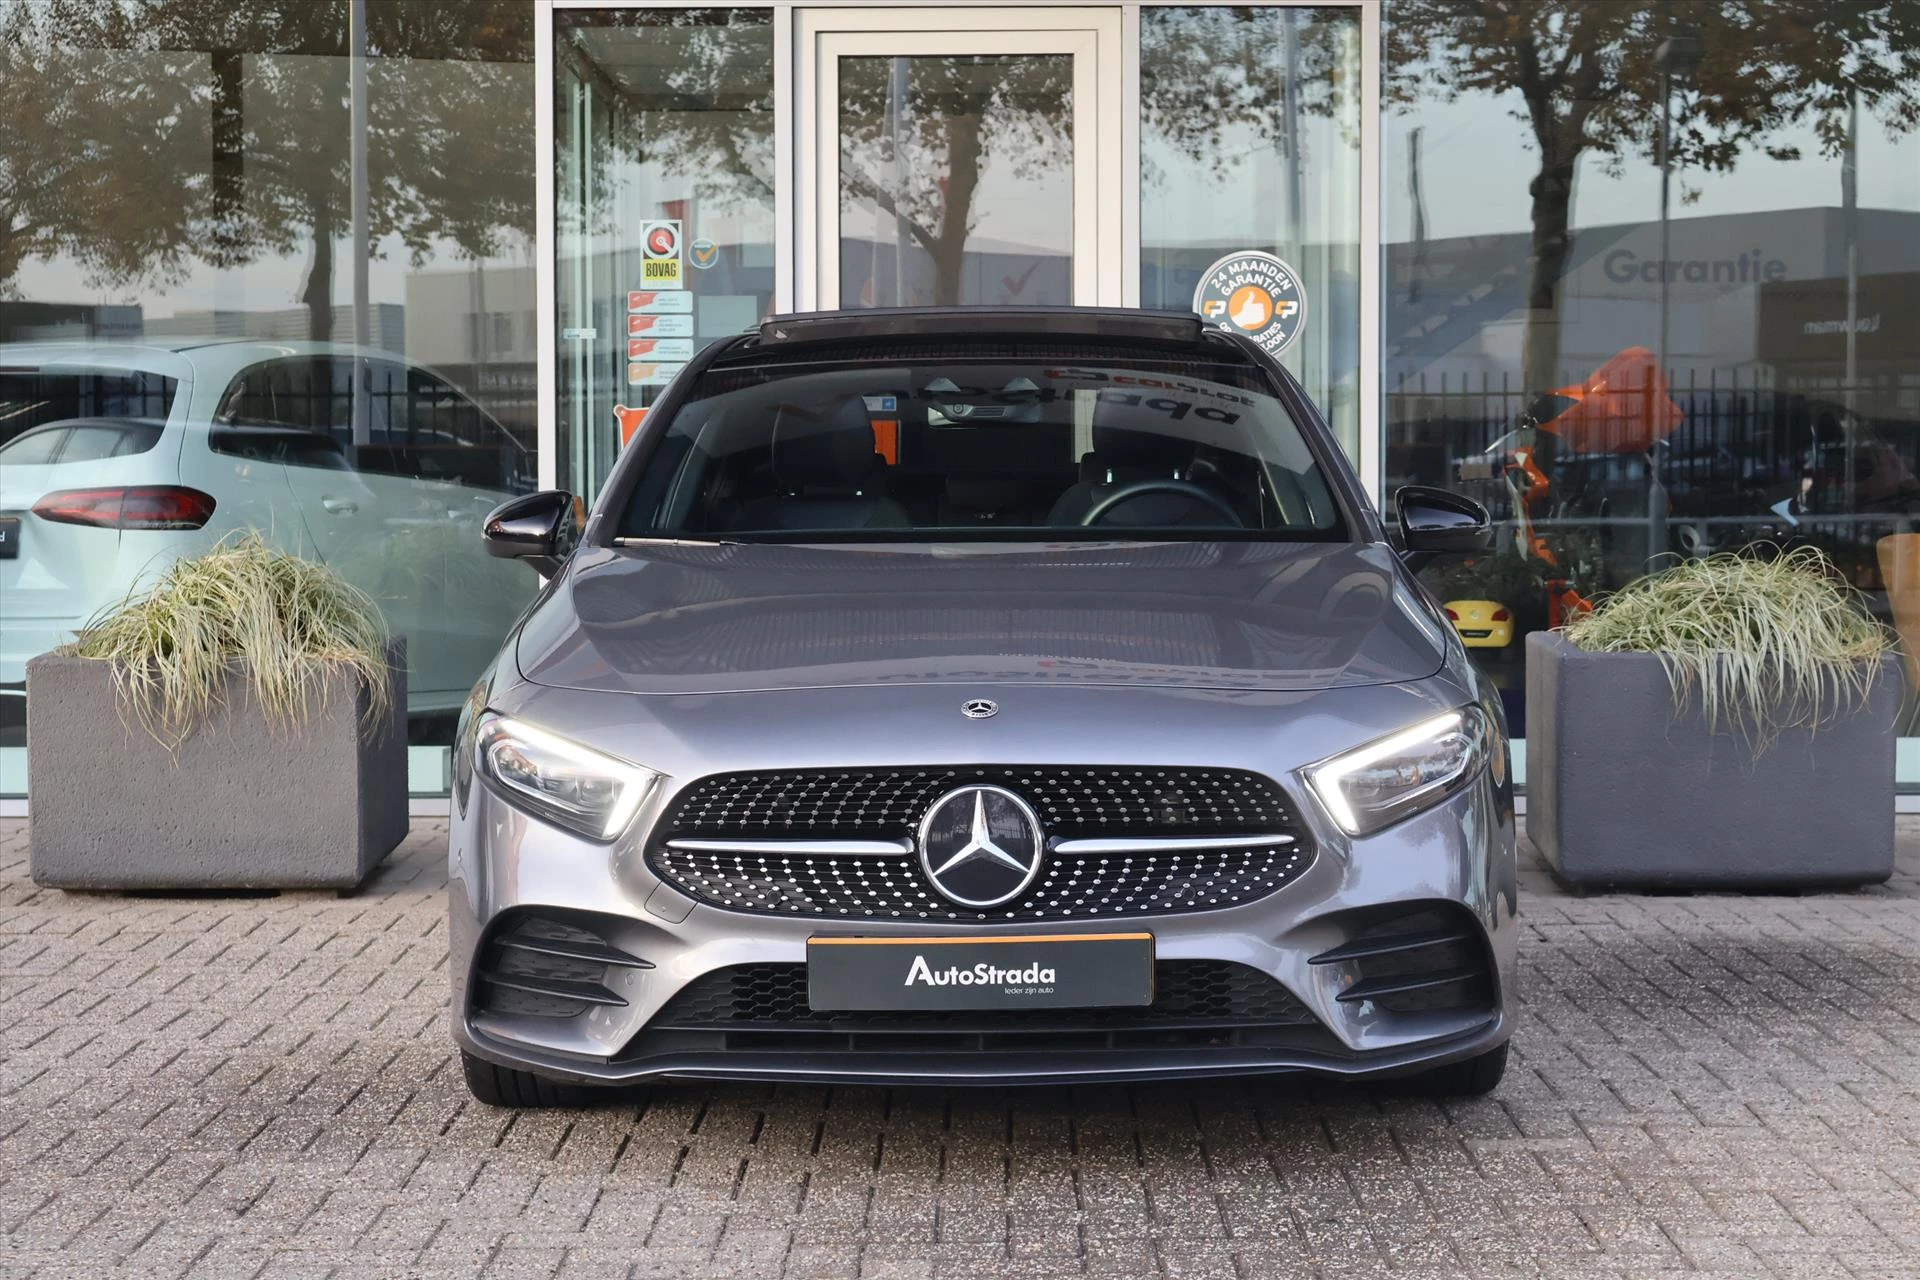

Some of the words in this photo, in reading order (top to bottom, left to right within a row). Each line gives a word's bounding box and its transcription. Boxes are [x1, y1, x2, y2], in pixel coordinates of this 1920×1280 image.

[646, 263, 677, 278] BOVAG
[1211, 271, 1228, 289] 24
[1228, 261, 1293, 291] MAANDEN
[1603, 249, 1787, 284] Garantie
[1221, 273, 1282, 298] GARANTIE
[1248, 321, 1281, 344] RATIES
[1260, 331, 1286, 351] LOON
[904, 955, 1056, 986] AutoStrada
[1038, 986, 1054, 994] auto
